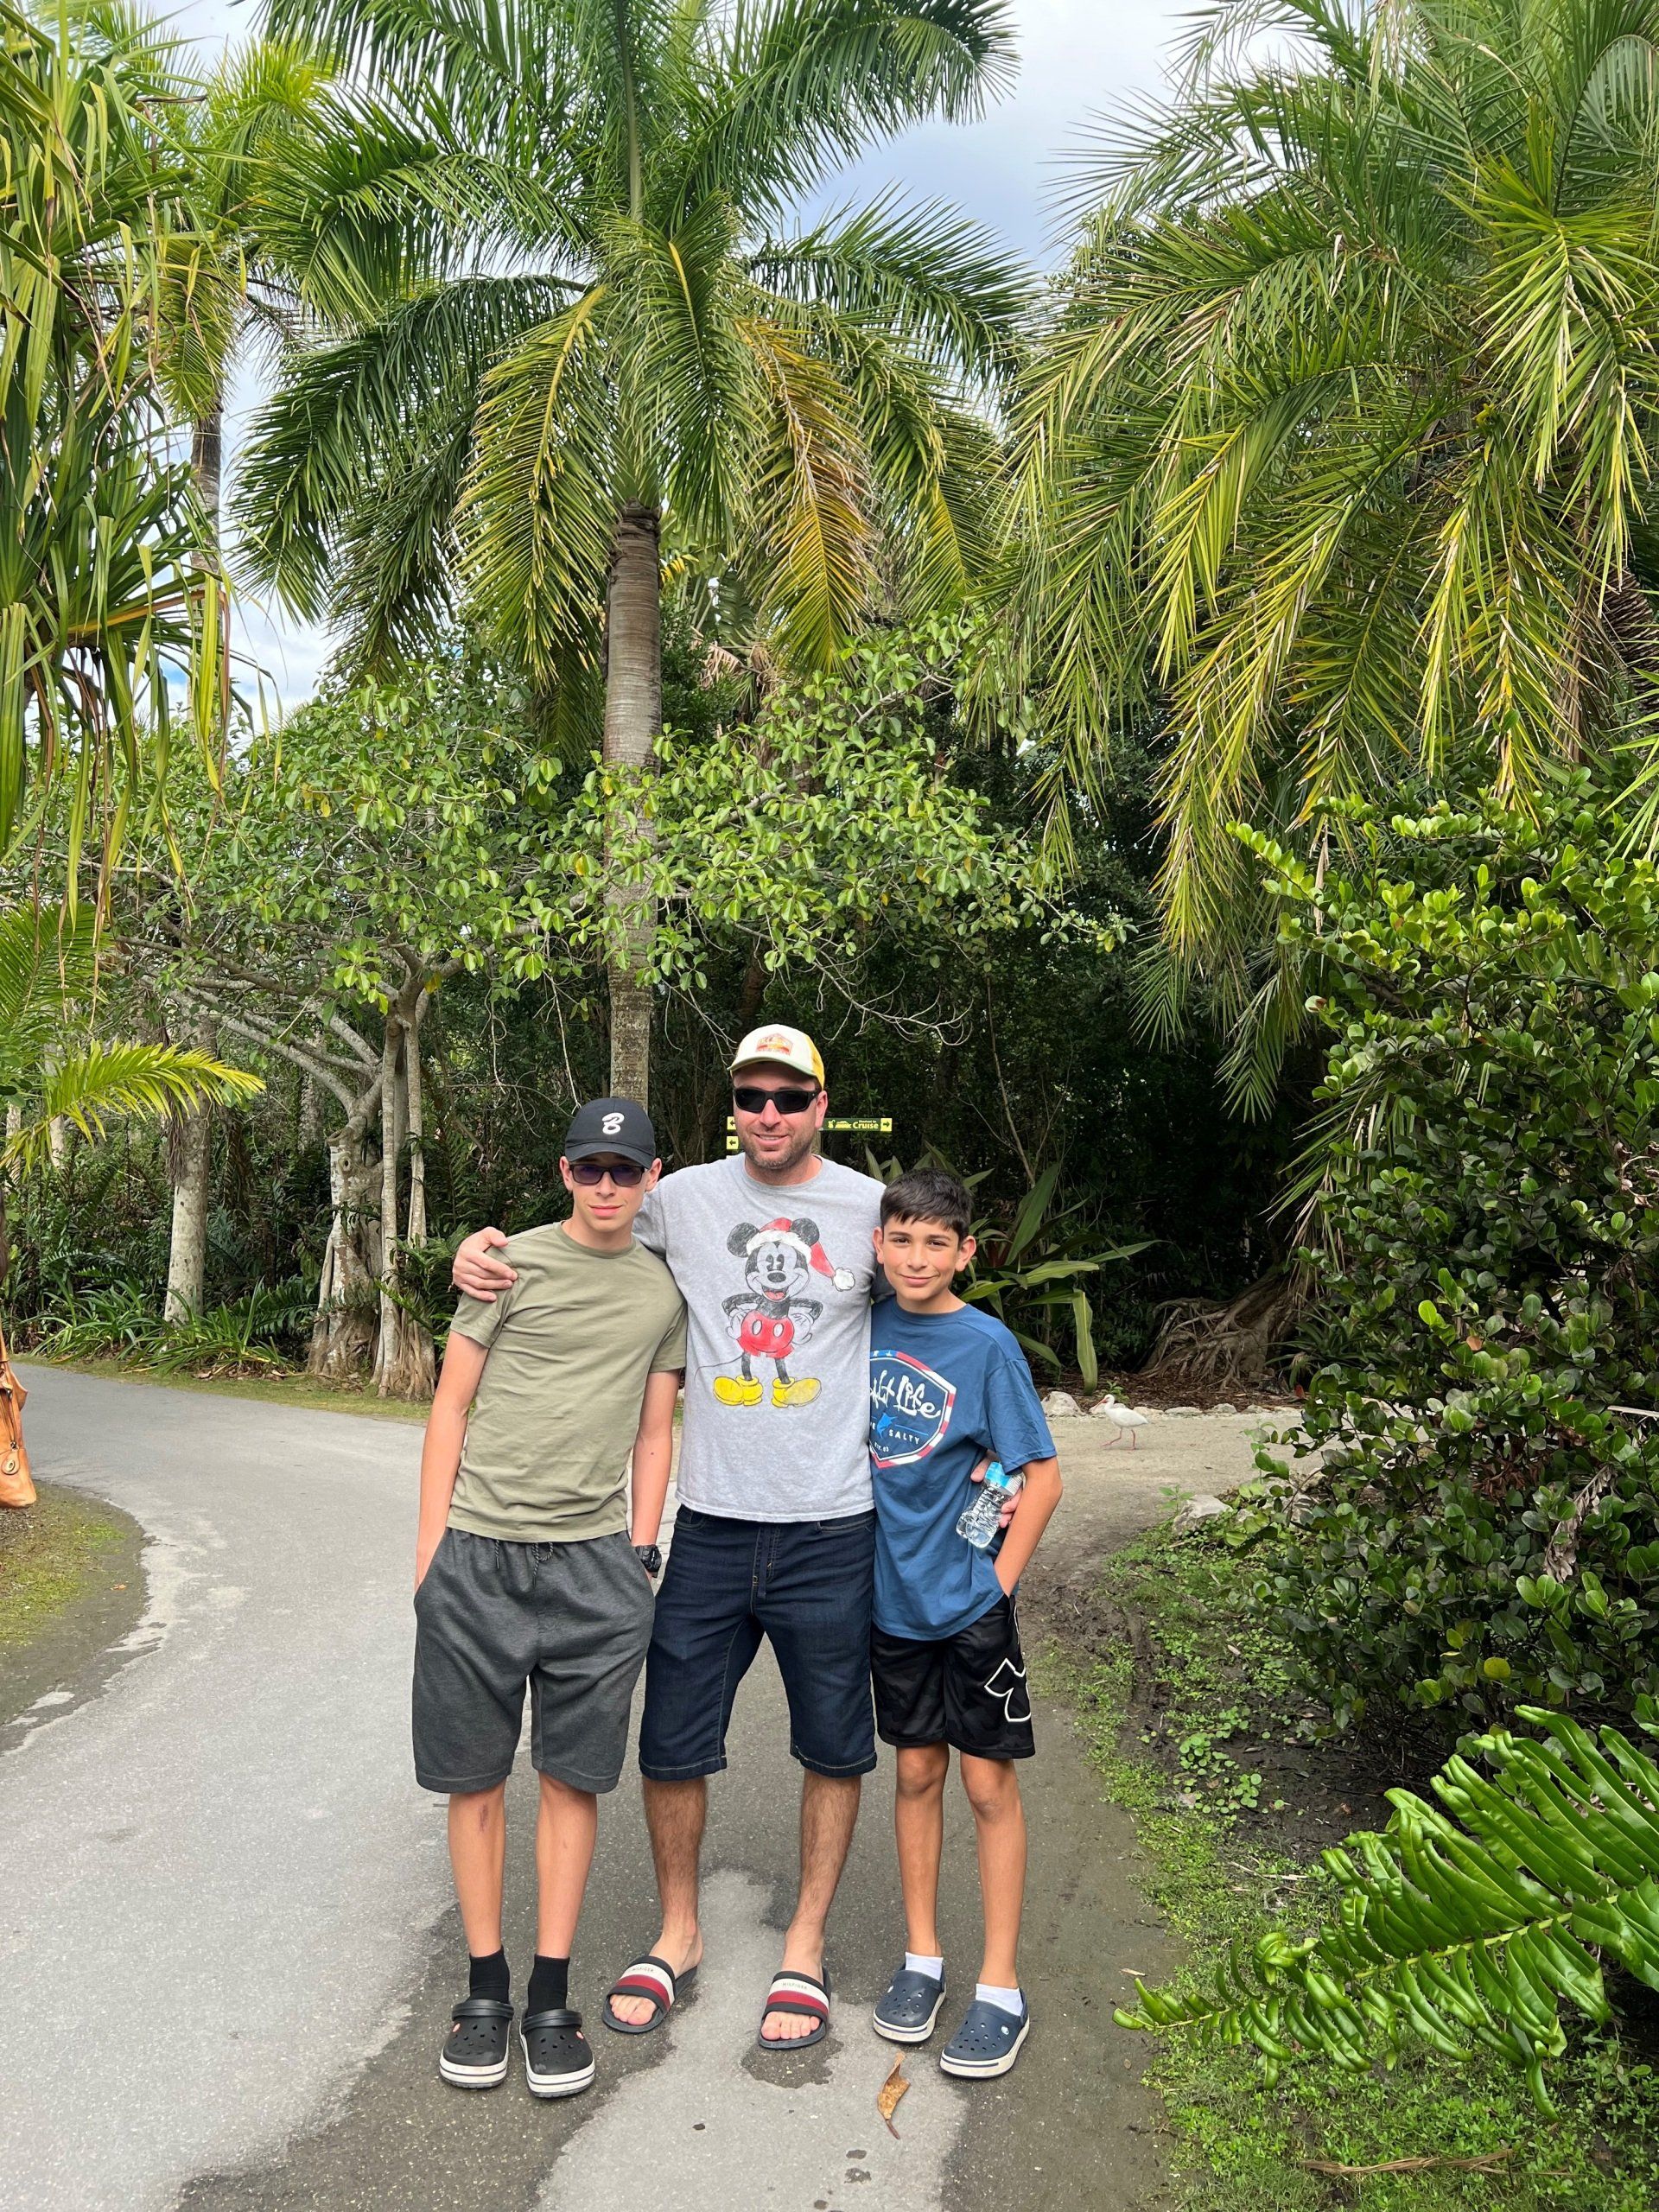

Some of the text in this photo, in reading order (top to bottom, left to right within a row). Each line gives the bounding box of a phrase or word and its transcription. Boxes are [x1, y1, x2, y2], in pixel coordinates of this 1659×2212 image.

[869, 1370, 942, 1419] alt Life
[888, 1429, 920, 1445] SALTY
